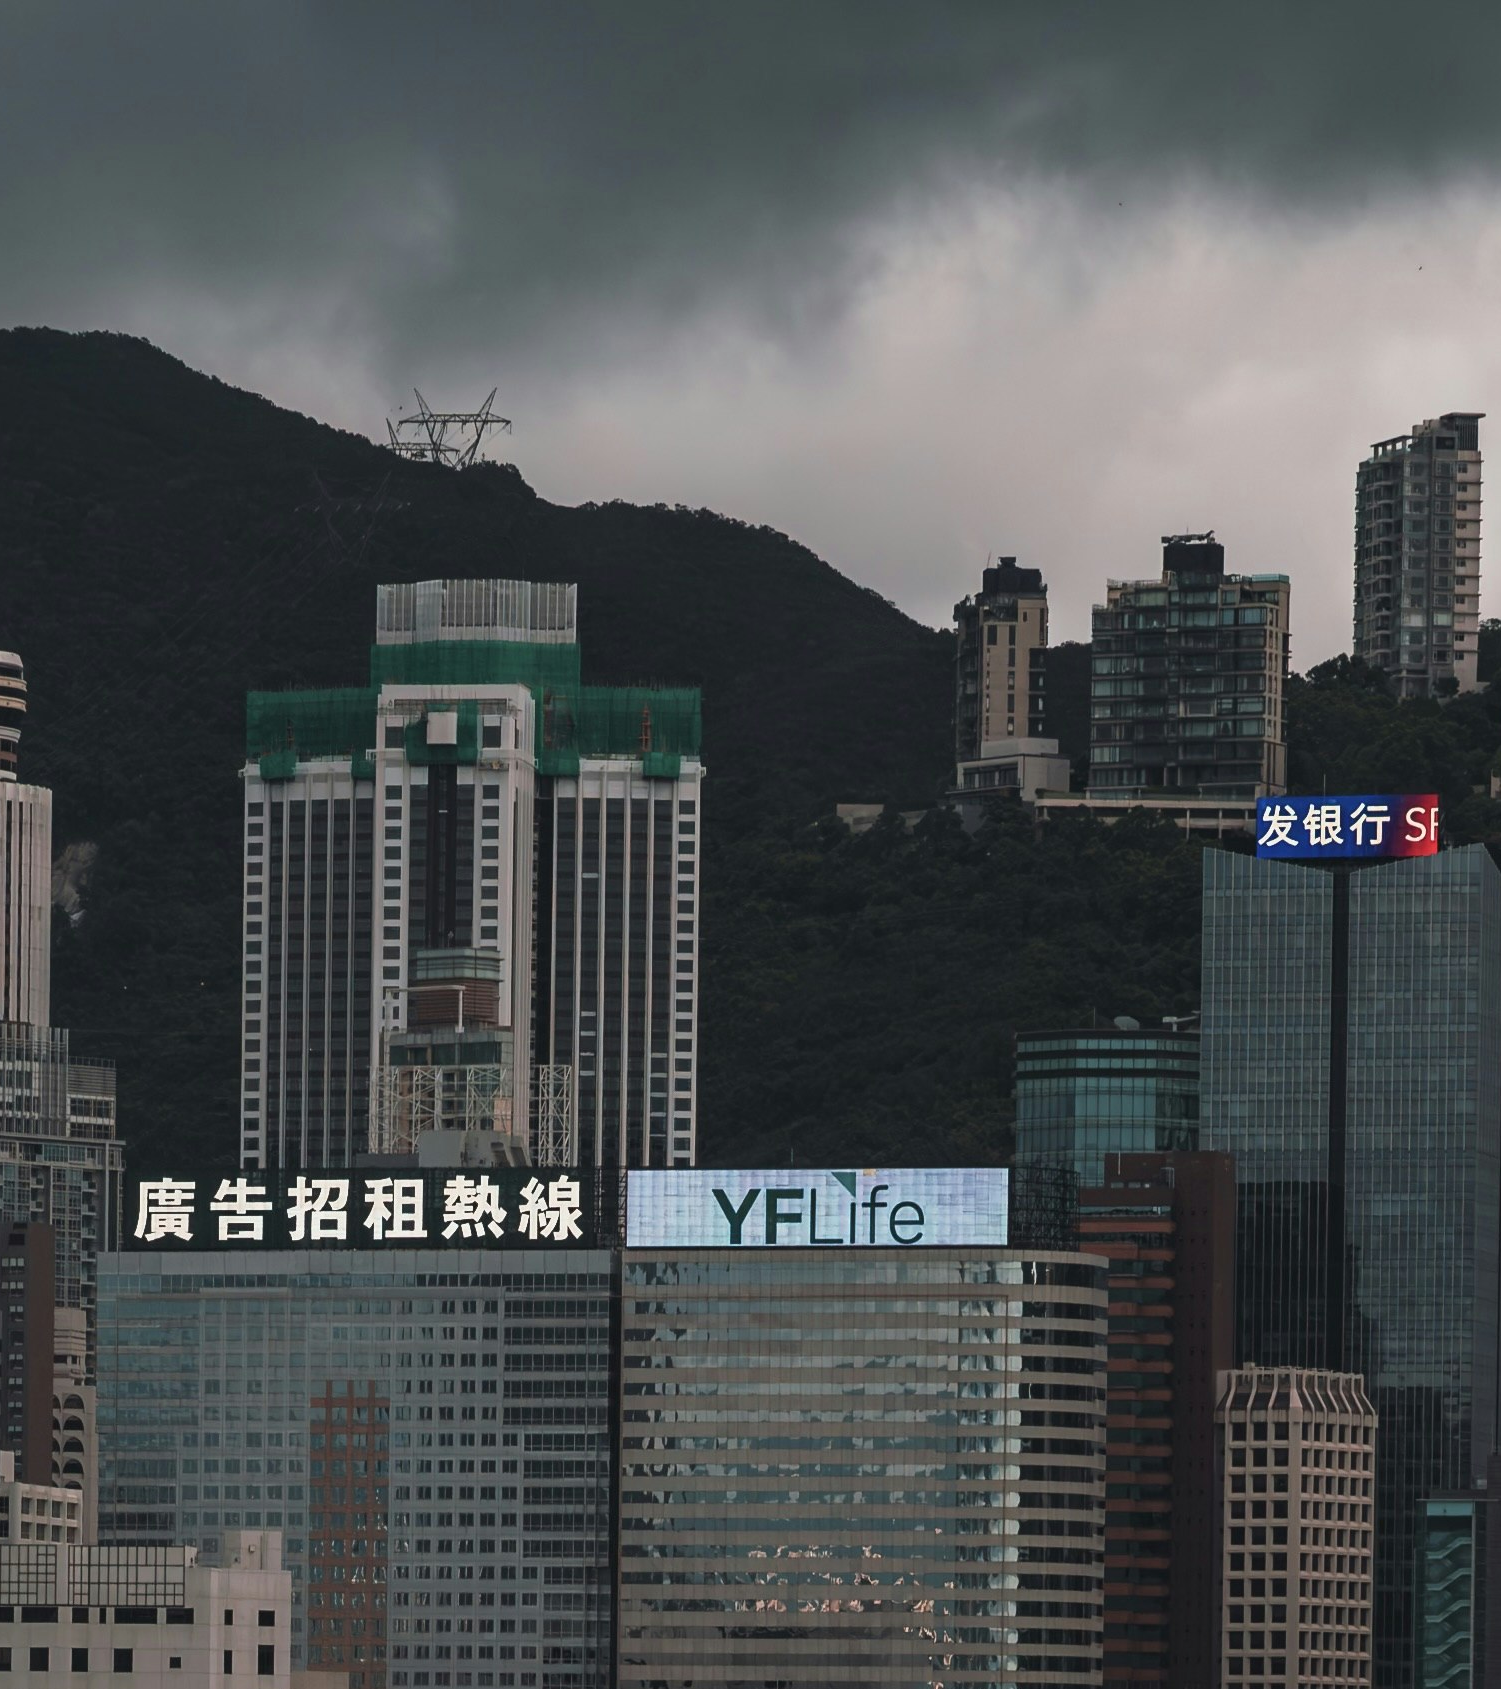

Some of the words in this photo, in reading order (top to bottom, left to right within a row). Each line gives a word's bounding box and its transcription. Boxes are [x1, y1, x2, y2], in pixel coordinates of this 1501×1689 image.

[1257, 802, 1391, 847] 发银行
[132, 1175, 586, 1242] 廣告招租熱線
[712, 1172, 926, 1246] YFLife
